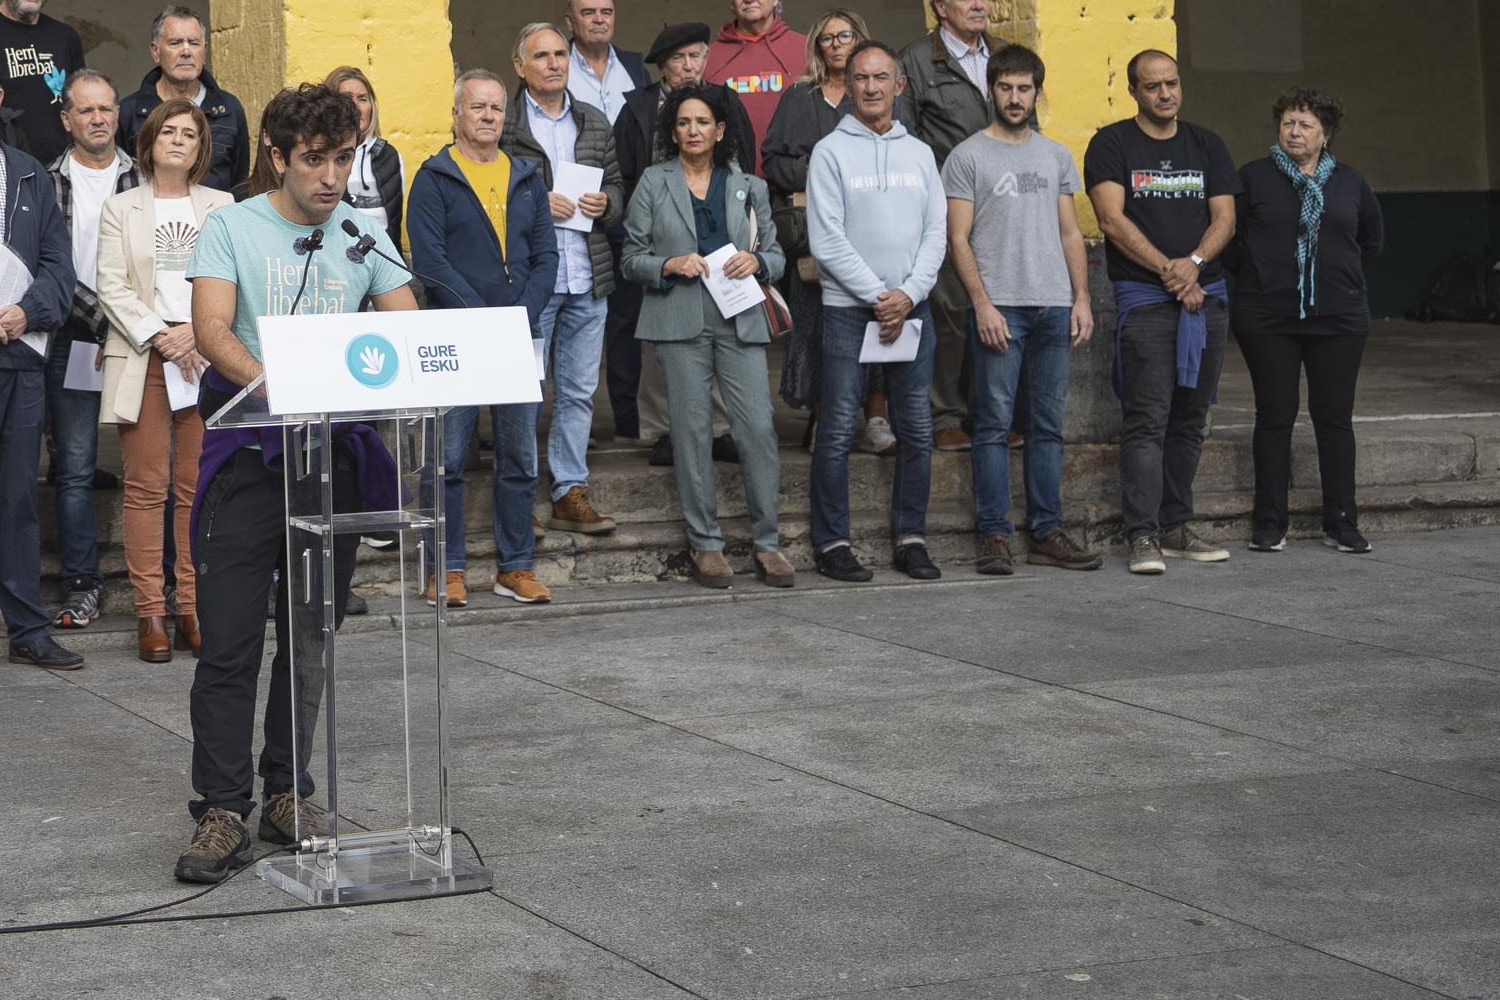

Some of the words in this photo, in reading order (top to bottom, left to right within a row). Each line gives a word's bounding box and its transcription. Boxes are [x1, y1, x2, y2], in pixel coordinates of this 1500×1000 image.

[4, 44, 38, 63] Herri
[1133, 189, 1205, 200] ATHLETIC
[417, 345, 457, 358] GURE
[420, 360, 459, 373] ESKU
